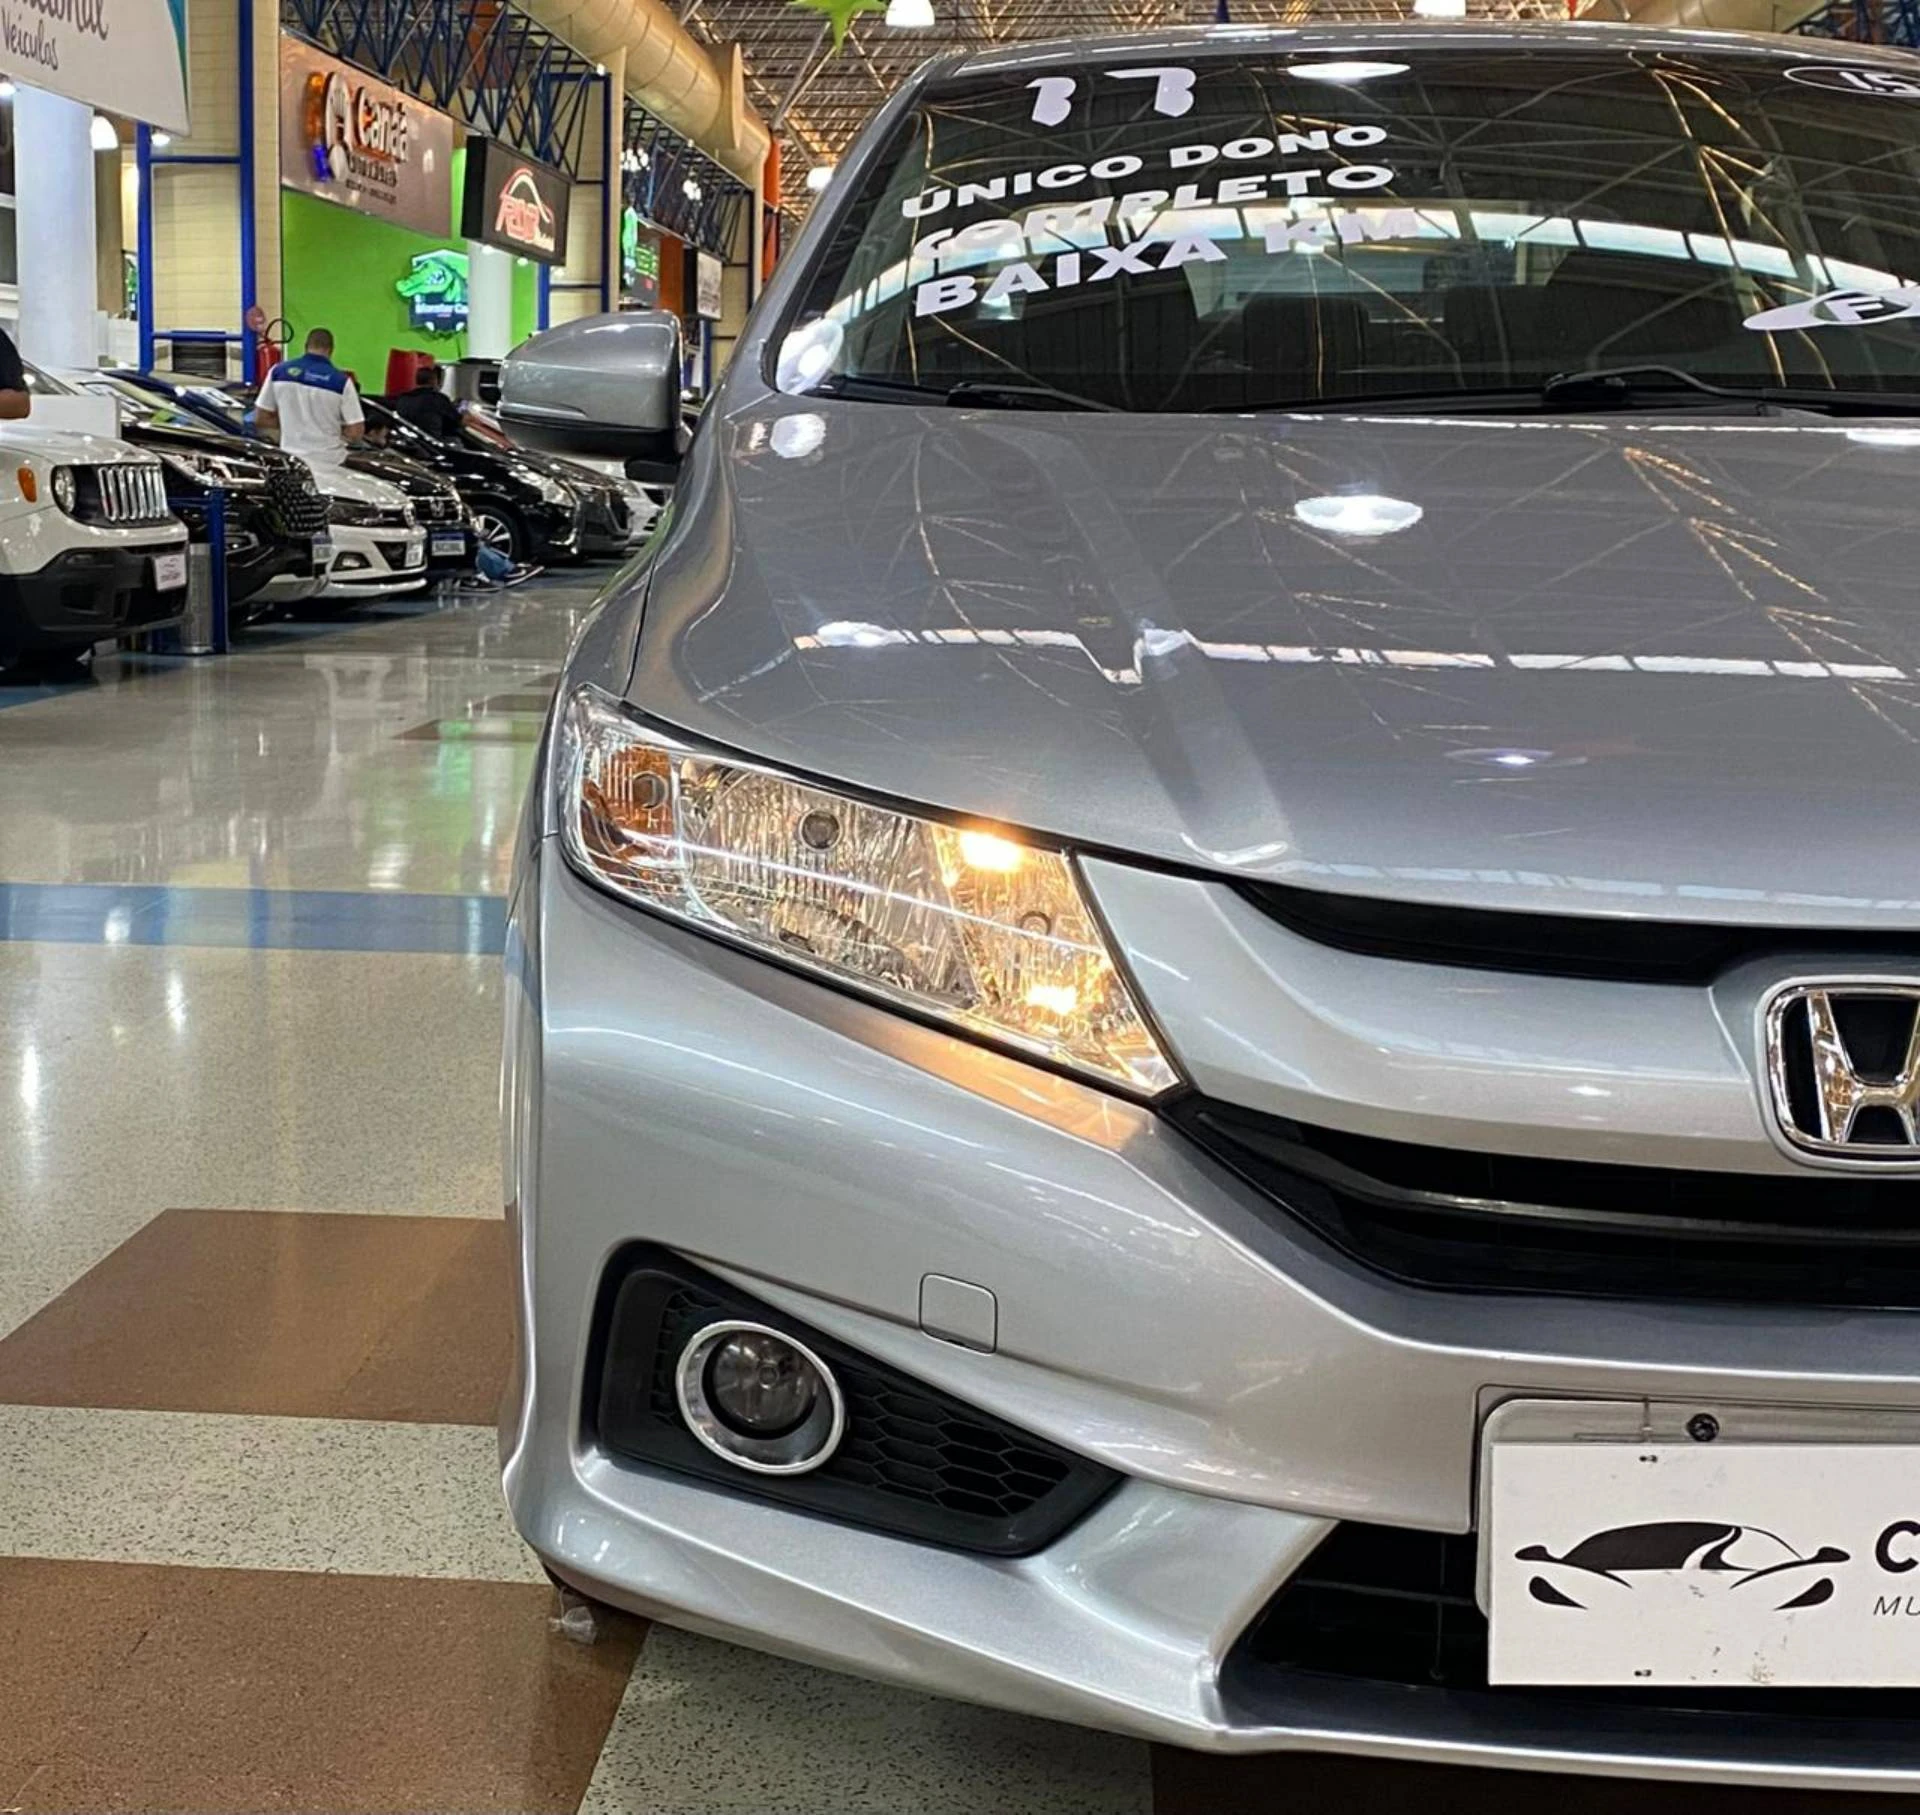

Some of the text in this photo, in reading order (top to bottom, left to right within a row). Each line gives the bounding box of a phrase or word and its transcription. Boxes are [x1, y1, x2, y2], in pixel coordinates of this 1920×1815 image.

[1169, 125, 1388, 169] DONO
[912, 164, 1395, 262] COMPLETO
[915, 207, 1420, 318] BAIXA KM
